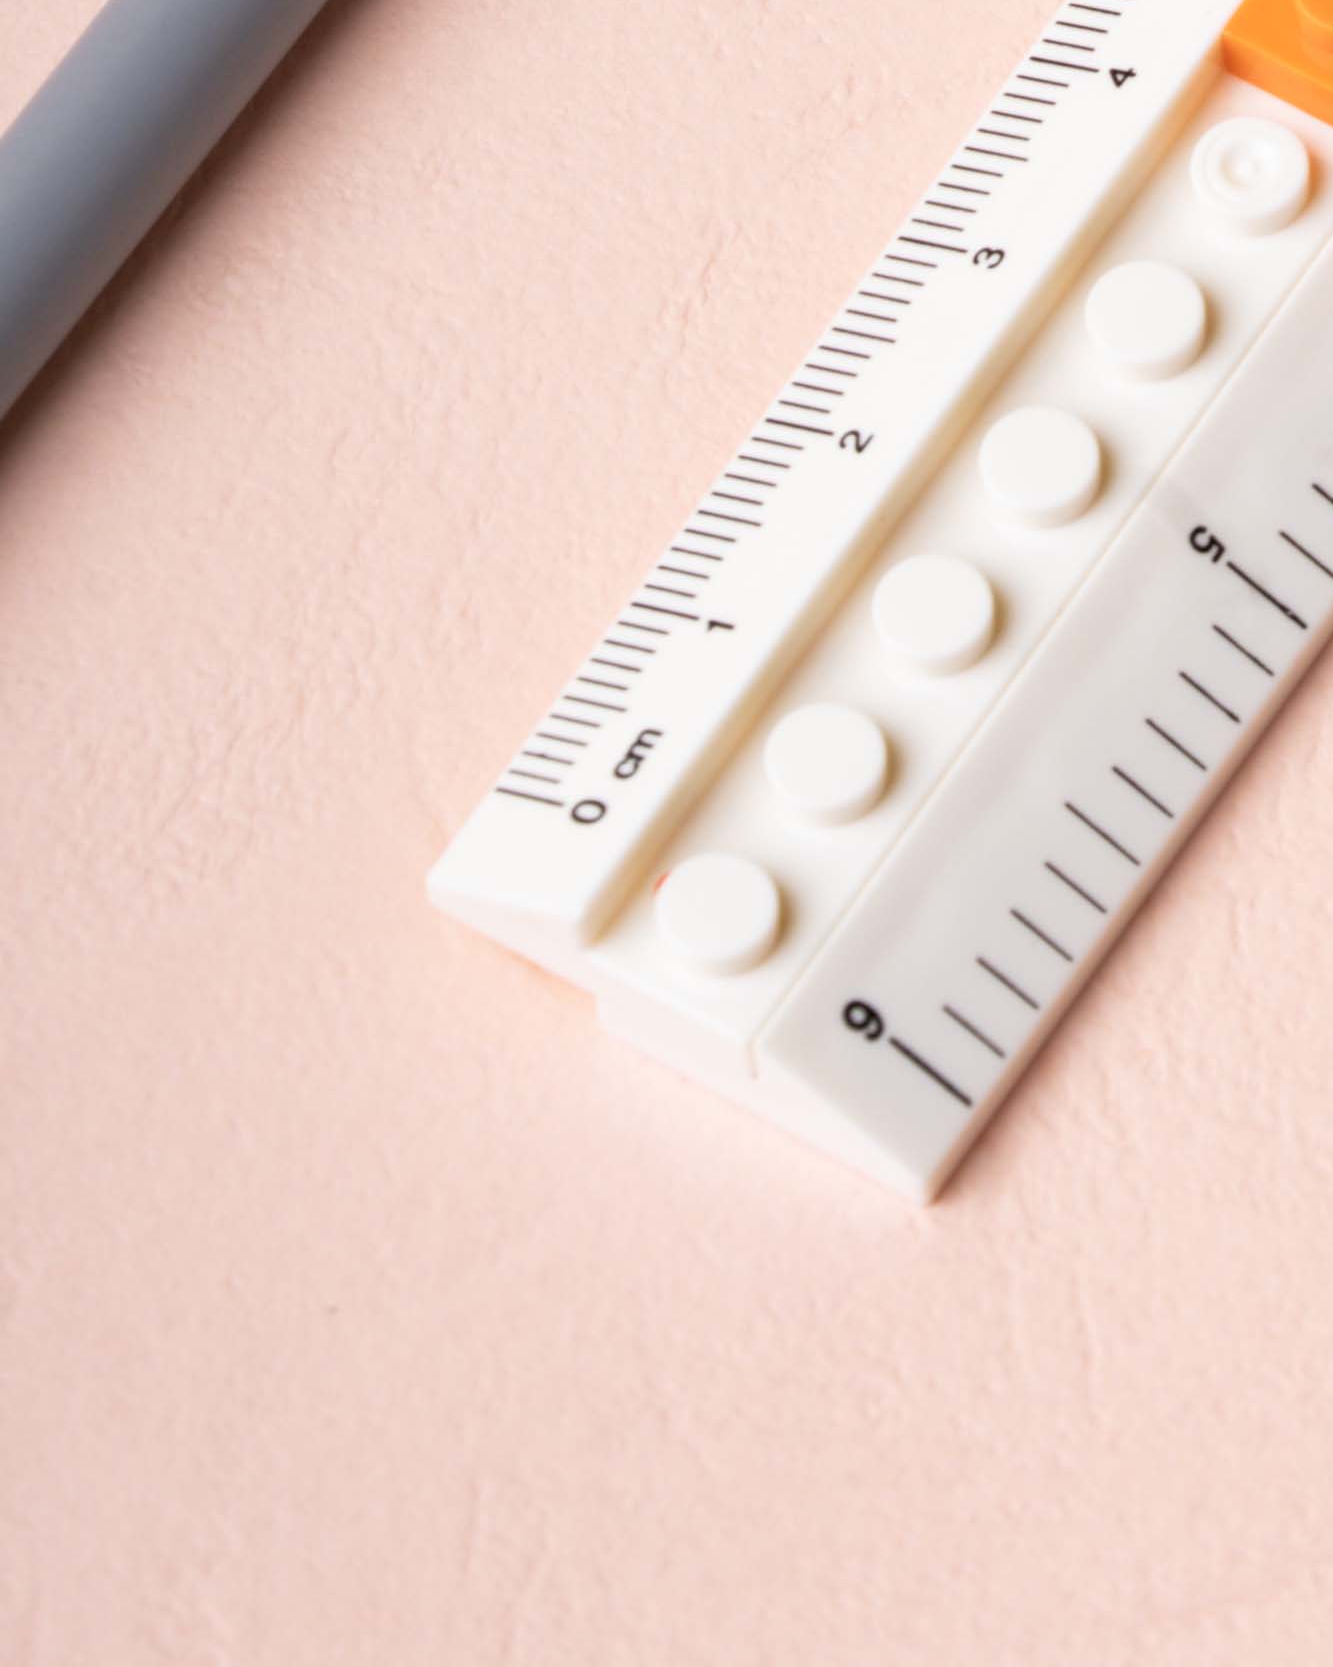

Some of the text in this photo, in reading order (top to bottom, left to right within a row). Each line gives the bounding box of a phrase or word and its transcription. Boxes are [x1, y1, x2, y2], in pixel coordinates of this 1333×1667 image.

[1108, 68, 1138, 89] 4
[972, 247, 1006, 270] 3
[839, 429, 873, 455] 2
[1187, 523, 1227, 565] 5
[706, 619, 736, 633] 1
[570, 727, 663, 824] 0 cm
[840, 998, 887, 1042] 6
